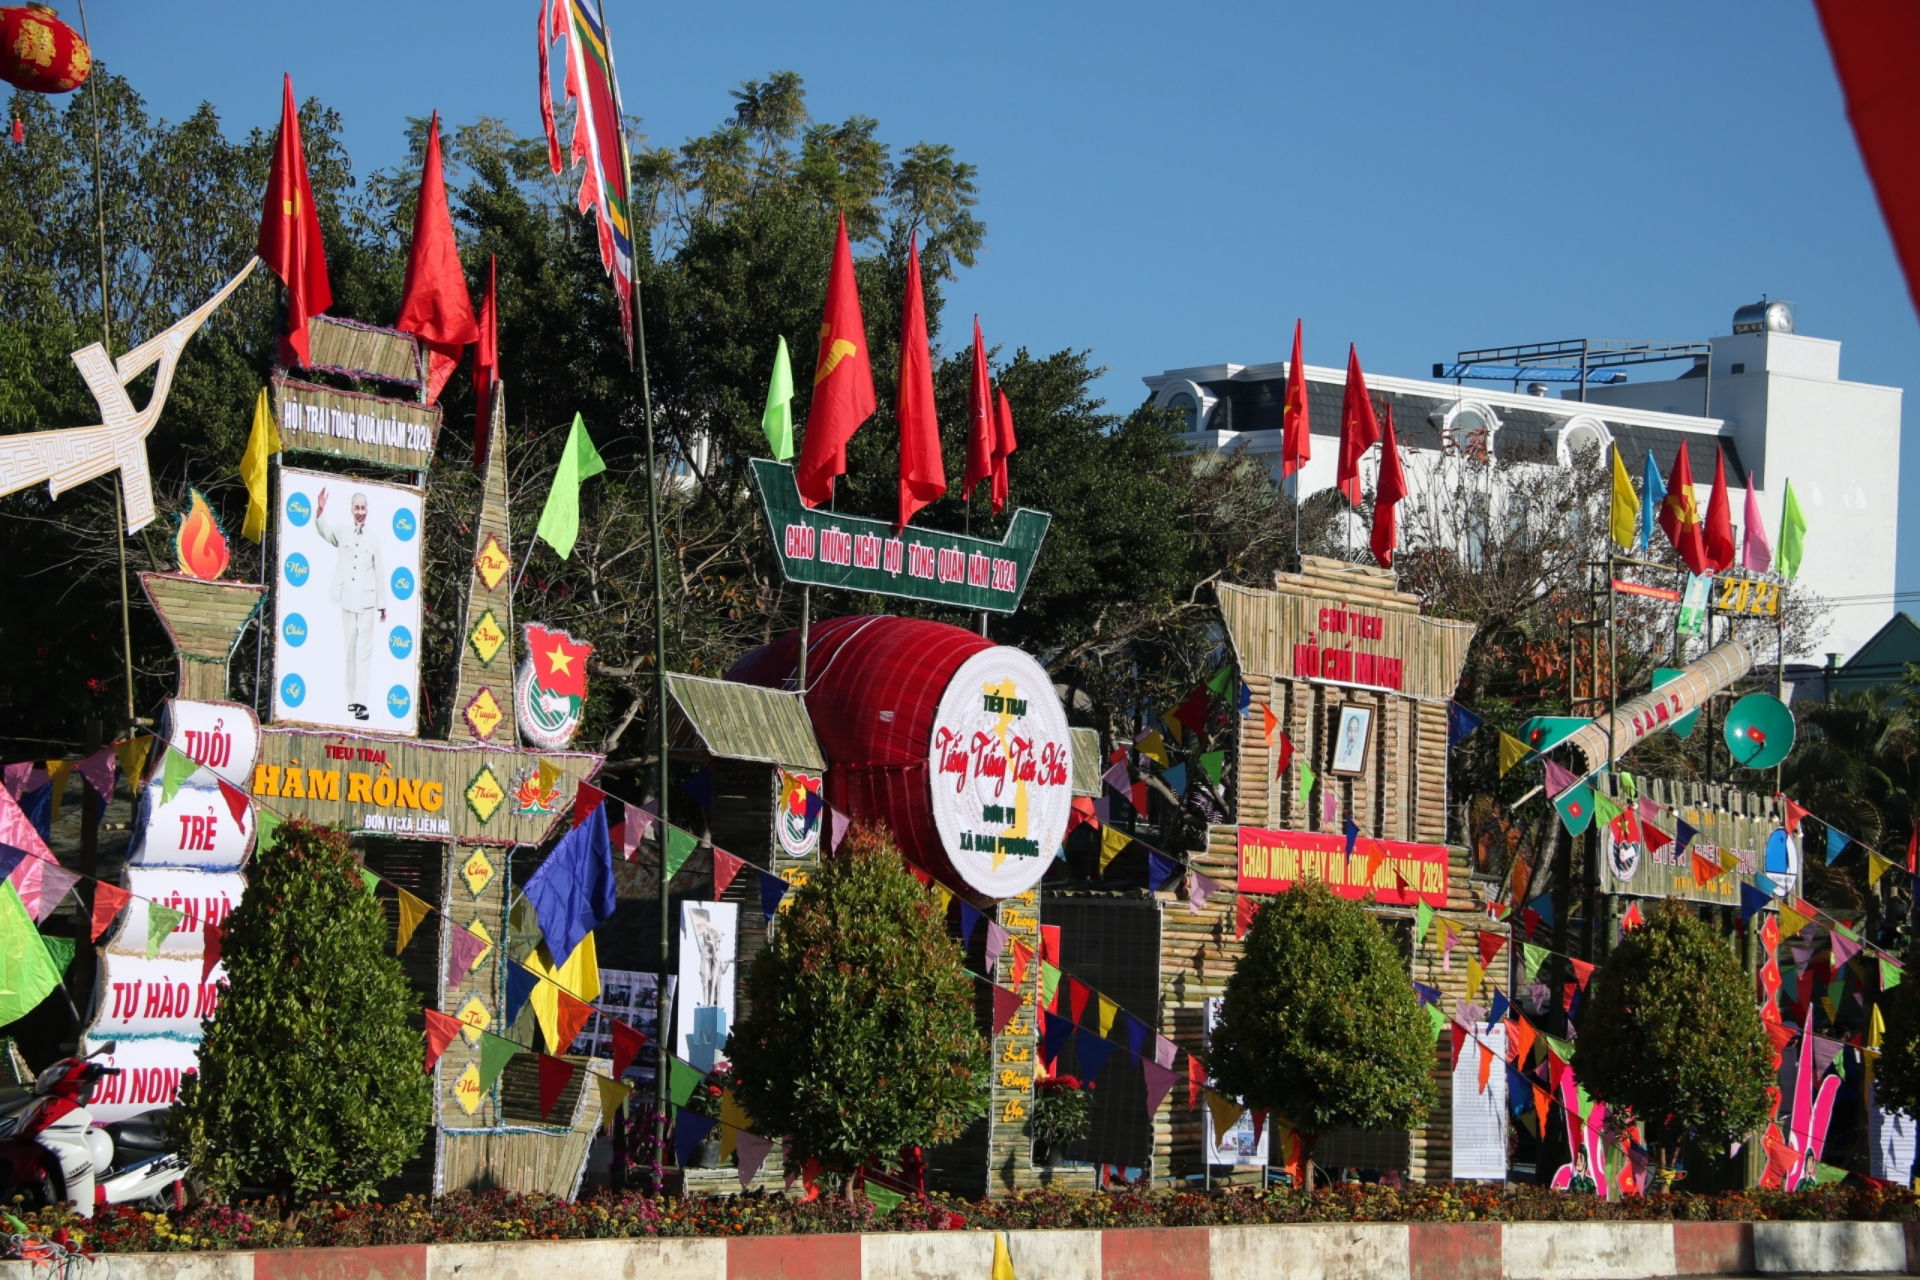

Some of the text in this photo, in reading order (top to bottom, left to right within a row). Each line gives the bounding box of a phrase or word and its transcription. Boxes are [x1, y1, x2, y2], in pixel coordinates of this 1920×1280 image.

[284, 396, 302, 434] HỘI
[305, 405, 330, 438] TRẠI
[356, 412, 383, 444] QUÂN
[384, 416, 406, 449] NĂM
[407, 423, 432, 451] 2024
[785, 521, 815, 560] CHÀO
[820, 526, 852, 566] MỪNG
[854, 531, 882, 570] NGÀY
[883, 537, 904, 578] HỘI
[938, 545, 965, 584] QUÂN
[968, 550, 990, 588] NĂM
[992, 558, 1017, 593] 2024
[1719, 577, 1779, 616] 2024
[1349, 612, 1383, 643] TỊCH
[1294, 631, 1402, 690] HỒ CHÍ MINH
[1006, 698, 1027, 720] TRẠI
[185, 718, 231, 768] TUỔI
[325, 737, 387, 766] TIỂU TRẠI
[253, 758, 444, 812] HÀM RỒNG
[179, 805, 218, 851] TRẺ
[364, 813, 385, 830] ĐƠN
[416, 815, 437, 832] LIÊN
[437, 816, 450, 833] HÀ
[960, 829, 973, 851] XÃ
[1243, 838, 1268, 880] CHÀO
[1270, 841, 1300, 882] MỪNG
[1302, 844, 1327, 883] NGÀY
[1329, 846, 1345, 891] HỘI
[1422, 862, 1444, 894] 2024
[112, 979, 142, 1024] TỰ
[143, 975, 190, 1019] HÀO
[129, 1067, 179, 1103] NON
[68, 1161, 89, 1176] YAMAHA
